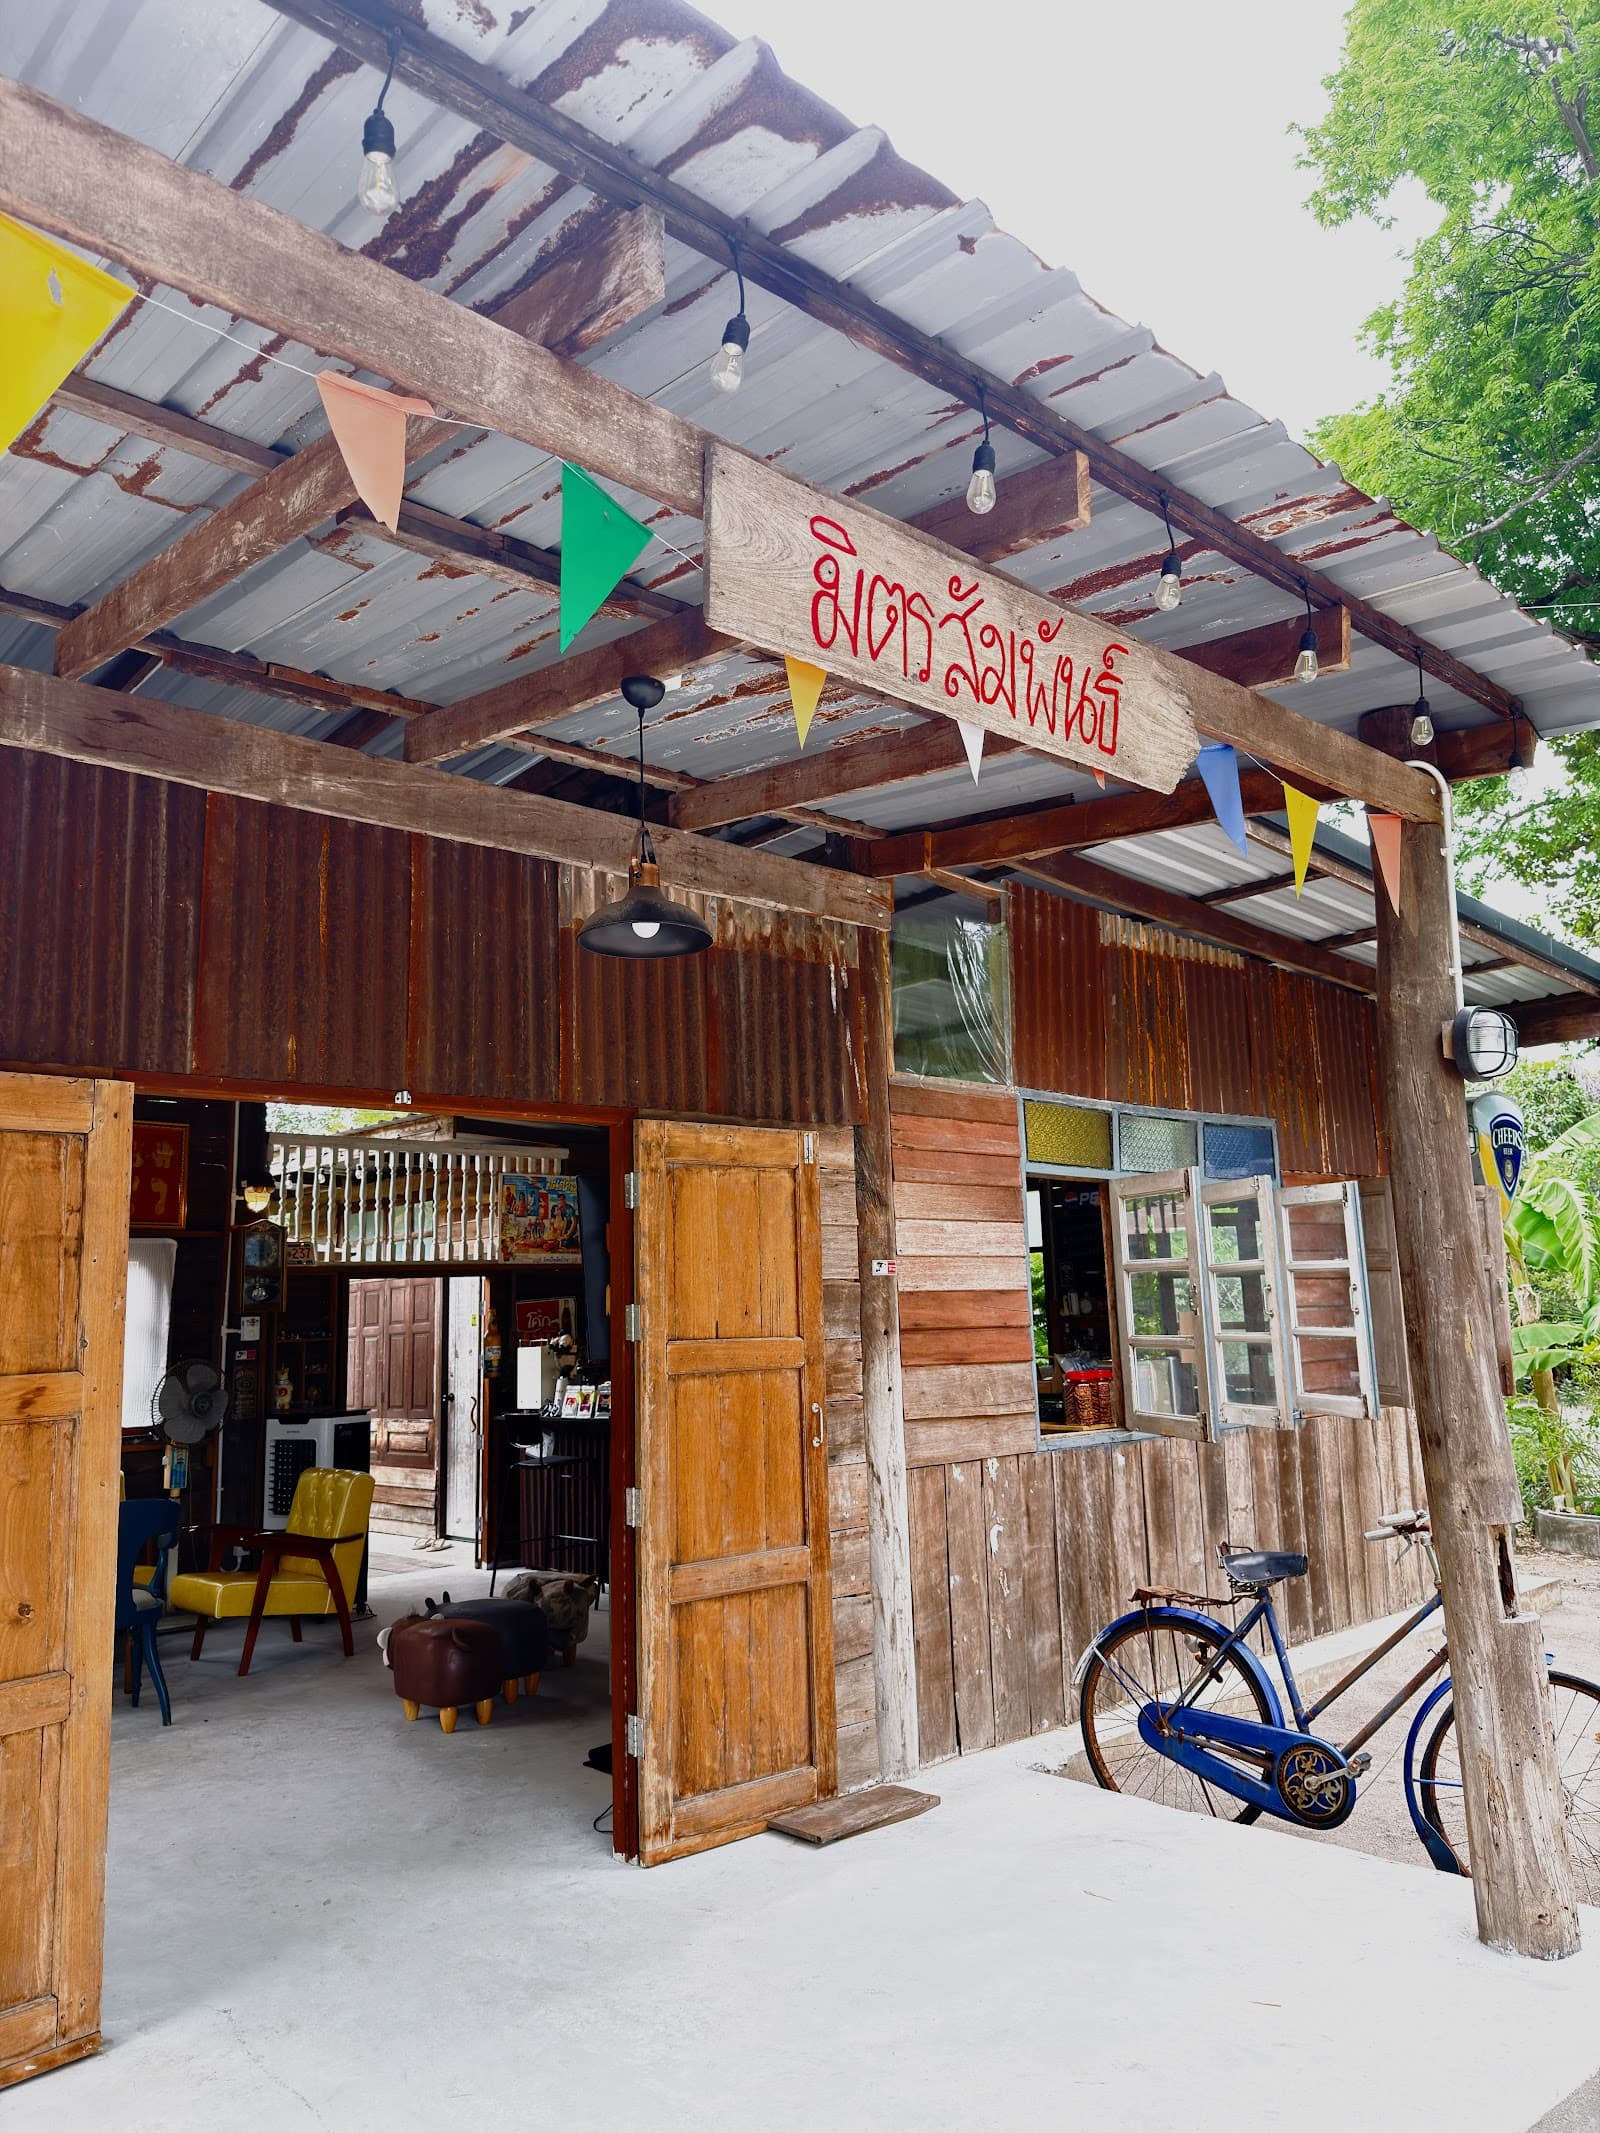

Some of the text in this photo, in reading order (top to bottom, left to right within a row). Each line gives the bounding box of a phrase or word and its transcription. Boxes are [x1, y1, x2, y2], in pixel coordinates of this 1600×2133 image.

[809, 515, 1129, 756] มิตรสัมพันธ์
[1493, 1127, 1523, 1150] CHEERS
